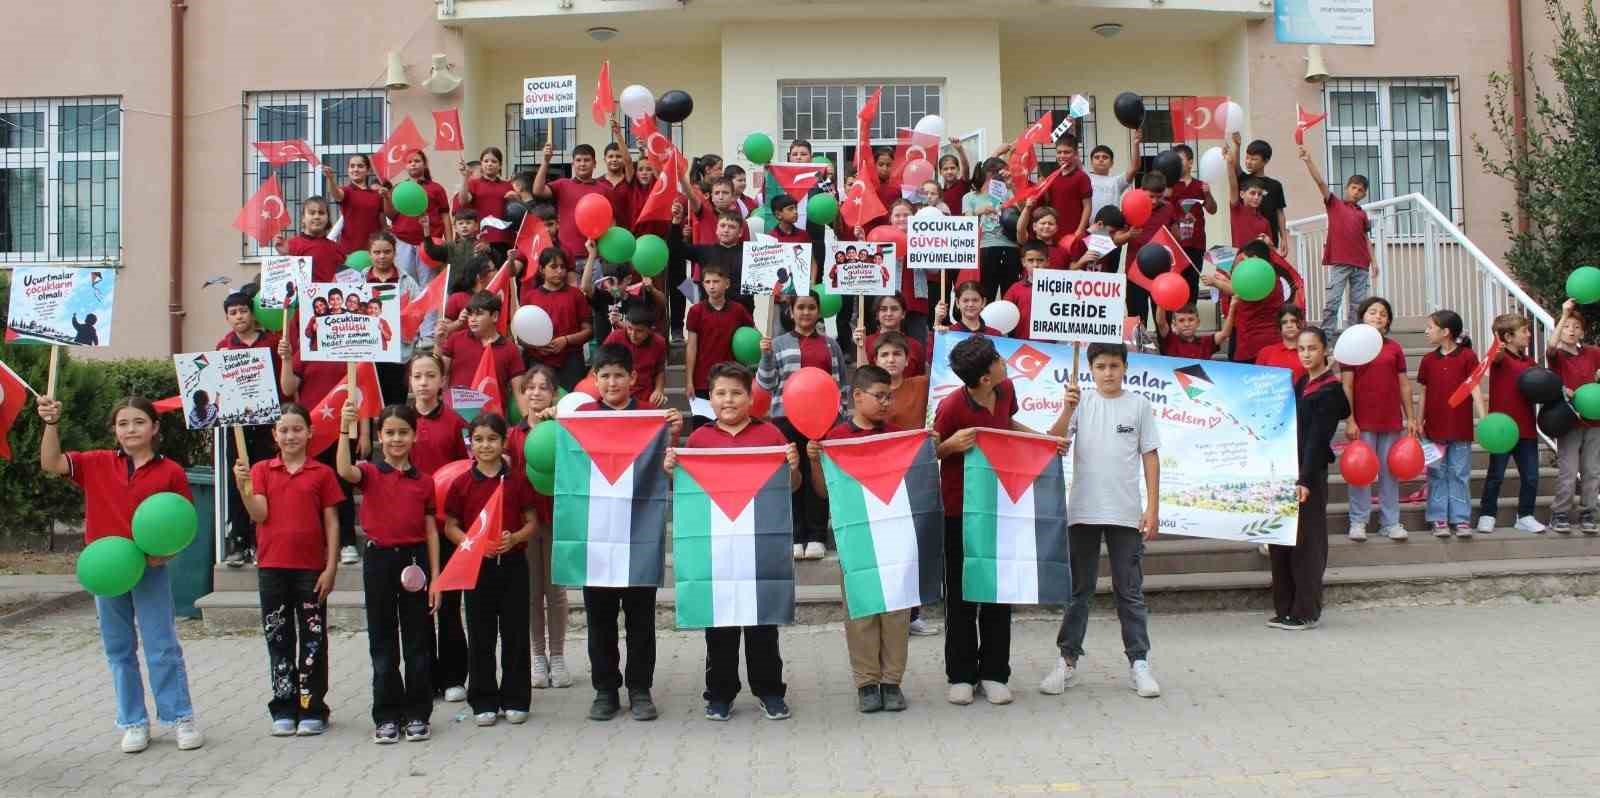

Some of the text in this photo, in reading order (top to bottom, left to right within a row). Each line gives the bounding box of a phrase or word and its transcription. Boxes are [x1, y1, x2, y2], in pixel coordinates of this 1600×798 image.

[527, 79, 573, 91] ÇOCUKLAR
[526, 92, 554, 103] GÜVEN
[912, 221, 974, 233] ÇOCUKLAR
[909, 234, 975, 248] GÜVEN İÇİNDE
[909, 250, 976, 263] BÜYÜMELİDİR!
[23, 271, 75, 287] Uçurtmalar
[25, 281, 73, 297] çocukların
[1037, 276, 1121, 300] HİÇBİR ÇOCUK
[38, 291, 63, 301] olmalı
[1049, 300, 1107, 319] GERİDE
[324, 315, 370, 326] Çocukların
[331, 323, 367, 335] gülüşü
[1033, 320, 1117, 337] BIRAKILMAMALIDIR
[326, 333, 345, 341] hiçbir
[321, 340, 342, 348] hedef
[1161, 406, 1206, 427] Kalsın
